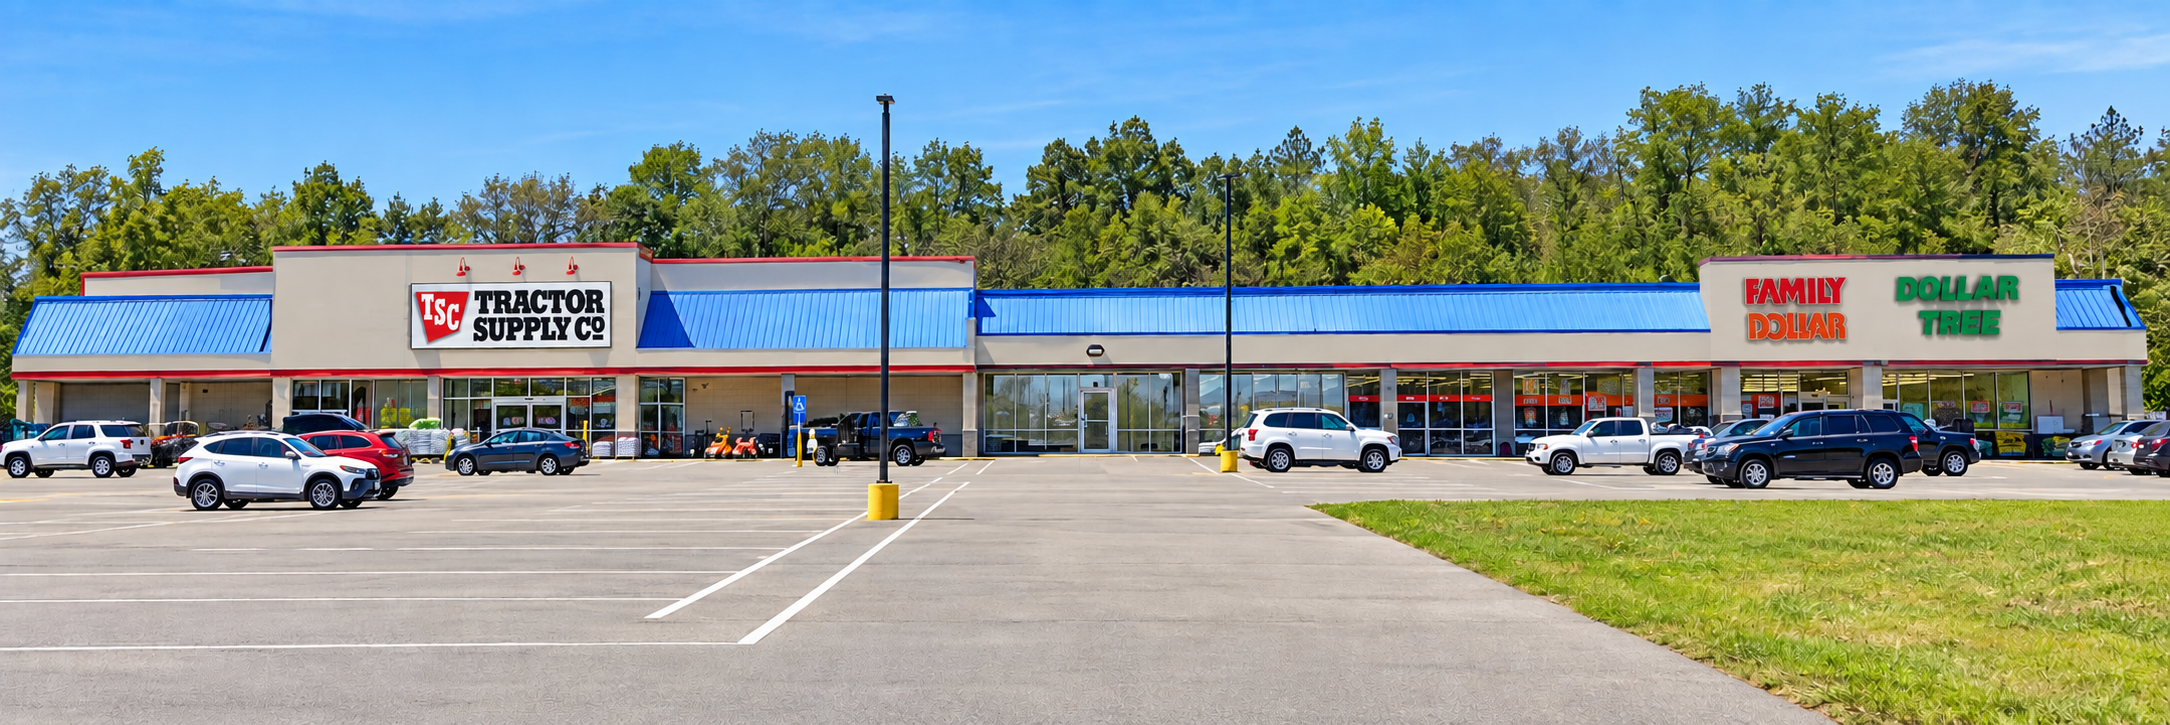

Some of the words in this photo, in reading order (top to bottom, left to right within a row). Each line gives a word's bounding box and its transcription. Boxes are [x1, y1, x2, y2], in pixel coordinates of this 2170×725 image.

[474, 289, 605, 314] TRACTOR
[1745, 277, 1847, 304] FAMILY
[1897, 275, 2020, 302] DOLLAR
[421, 293, 460, 331] TSC
[1918, 309, 2001, 336] TREE
[473, 317, 572, 342] SUPPLY
[1748, 312, 1847, 340] DOLLAR
